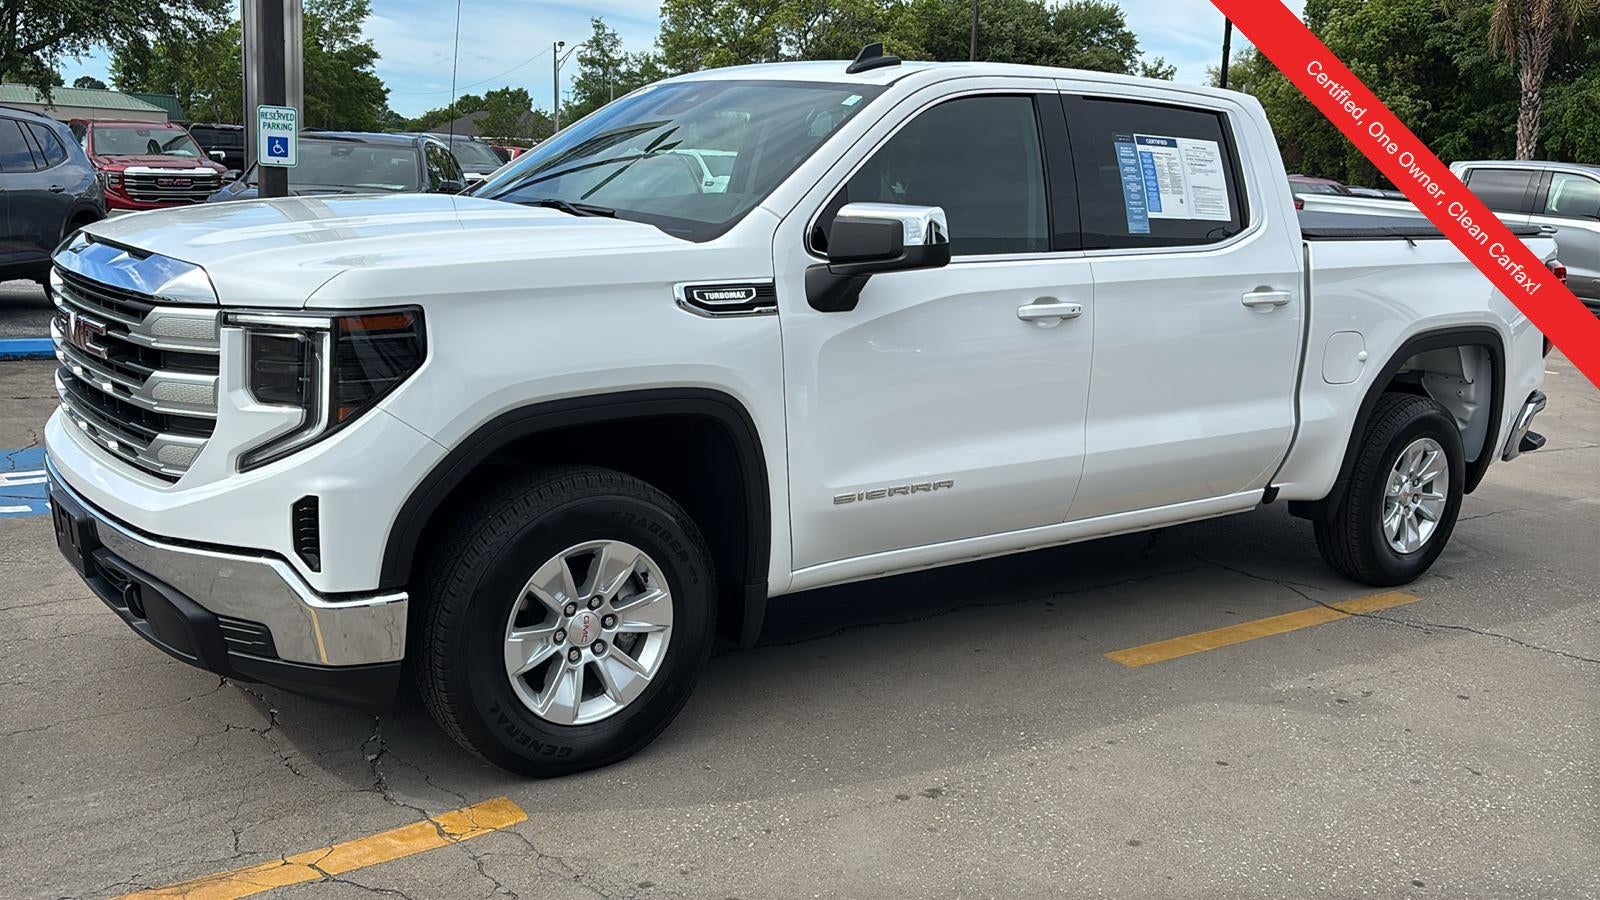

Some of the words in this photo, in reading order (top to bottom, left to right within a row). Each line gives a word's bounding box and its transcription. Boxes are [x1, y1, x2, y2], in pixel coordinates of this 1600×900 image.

[260, 111, 295, 121] RESERVED
[262, 122, 293, 131] PARKING
[1145, 138, 1168, 146] CERTIFIED
[157, 178, 192, 186] GMC
[704, 290, 746, 300] TURBOMAX
[56, 305, 108, 360] GMC
[833, 479, 954, 505] SIERRA
[581, 615, 590, 643] GMC
[489, 700, 573, 758] GENERAL
